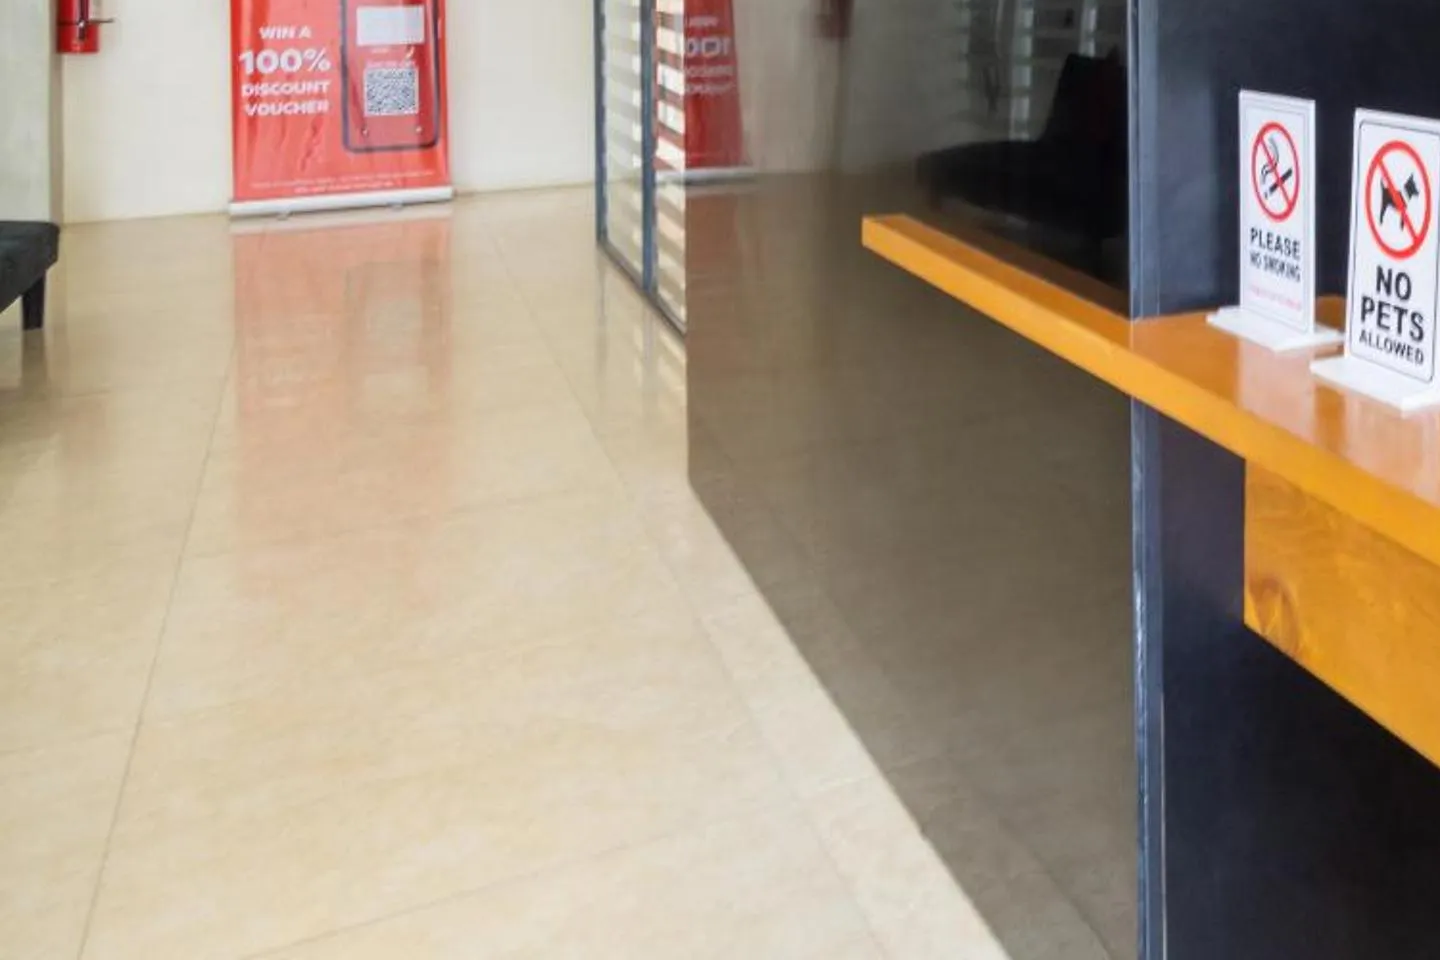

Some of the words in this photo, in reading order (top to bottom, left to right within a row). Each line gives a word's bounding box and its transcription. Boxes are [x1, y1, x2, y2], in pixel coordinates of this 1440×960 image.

[260, 26, 296, 40] WIN
[299, 25, 312, 38] A
[239, 47, 331, 74] 100%
[241, 80, 331, 97] DISCOUNT
[244, 99, 329, 116] VOUCHER
[1250, 227, 1300, 260] PLEASE
[1250, 250, 1262, 269] NO
[1263, 255, 1301, 282] SMOKING
[1376, 265, 1412, 300] NO
[1361, 295, 1424, 343] PETS
[1359, 329, 1424, 365] ALLOWED
